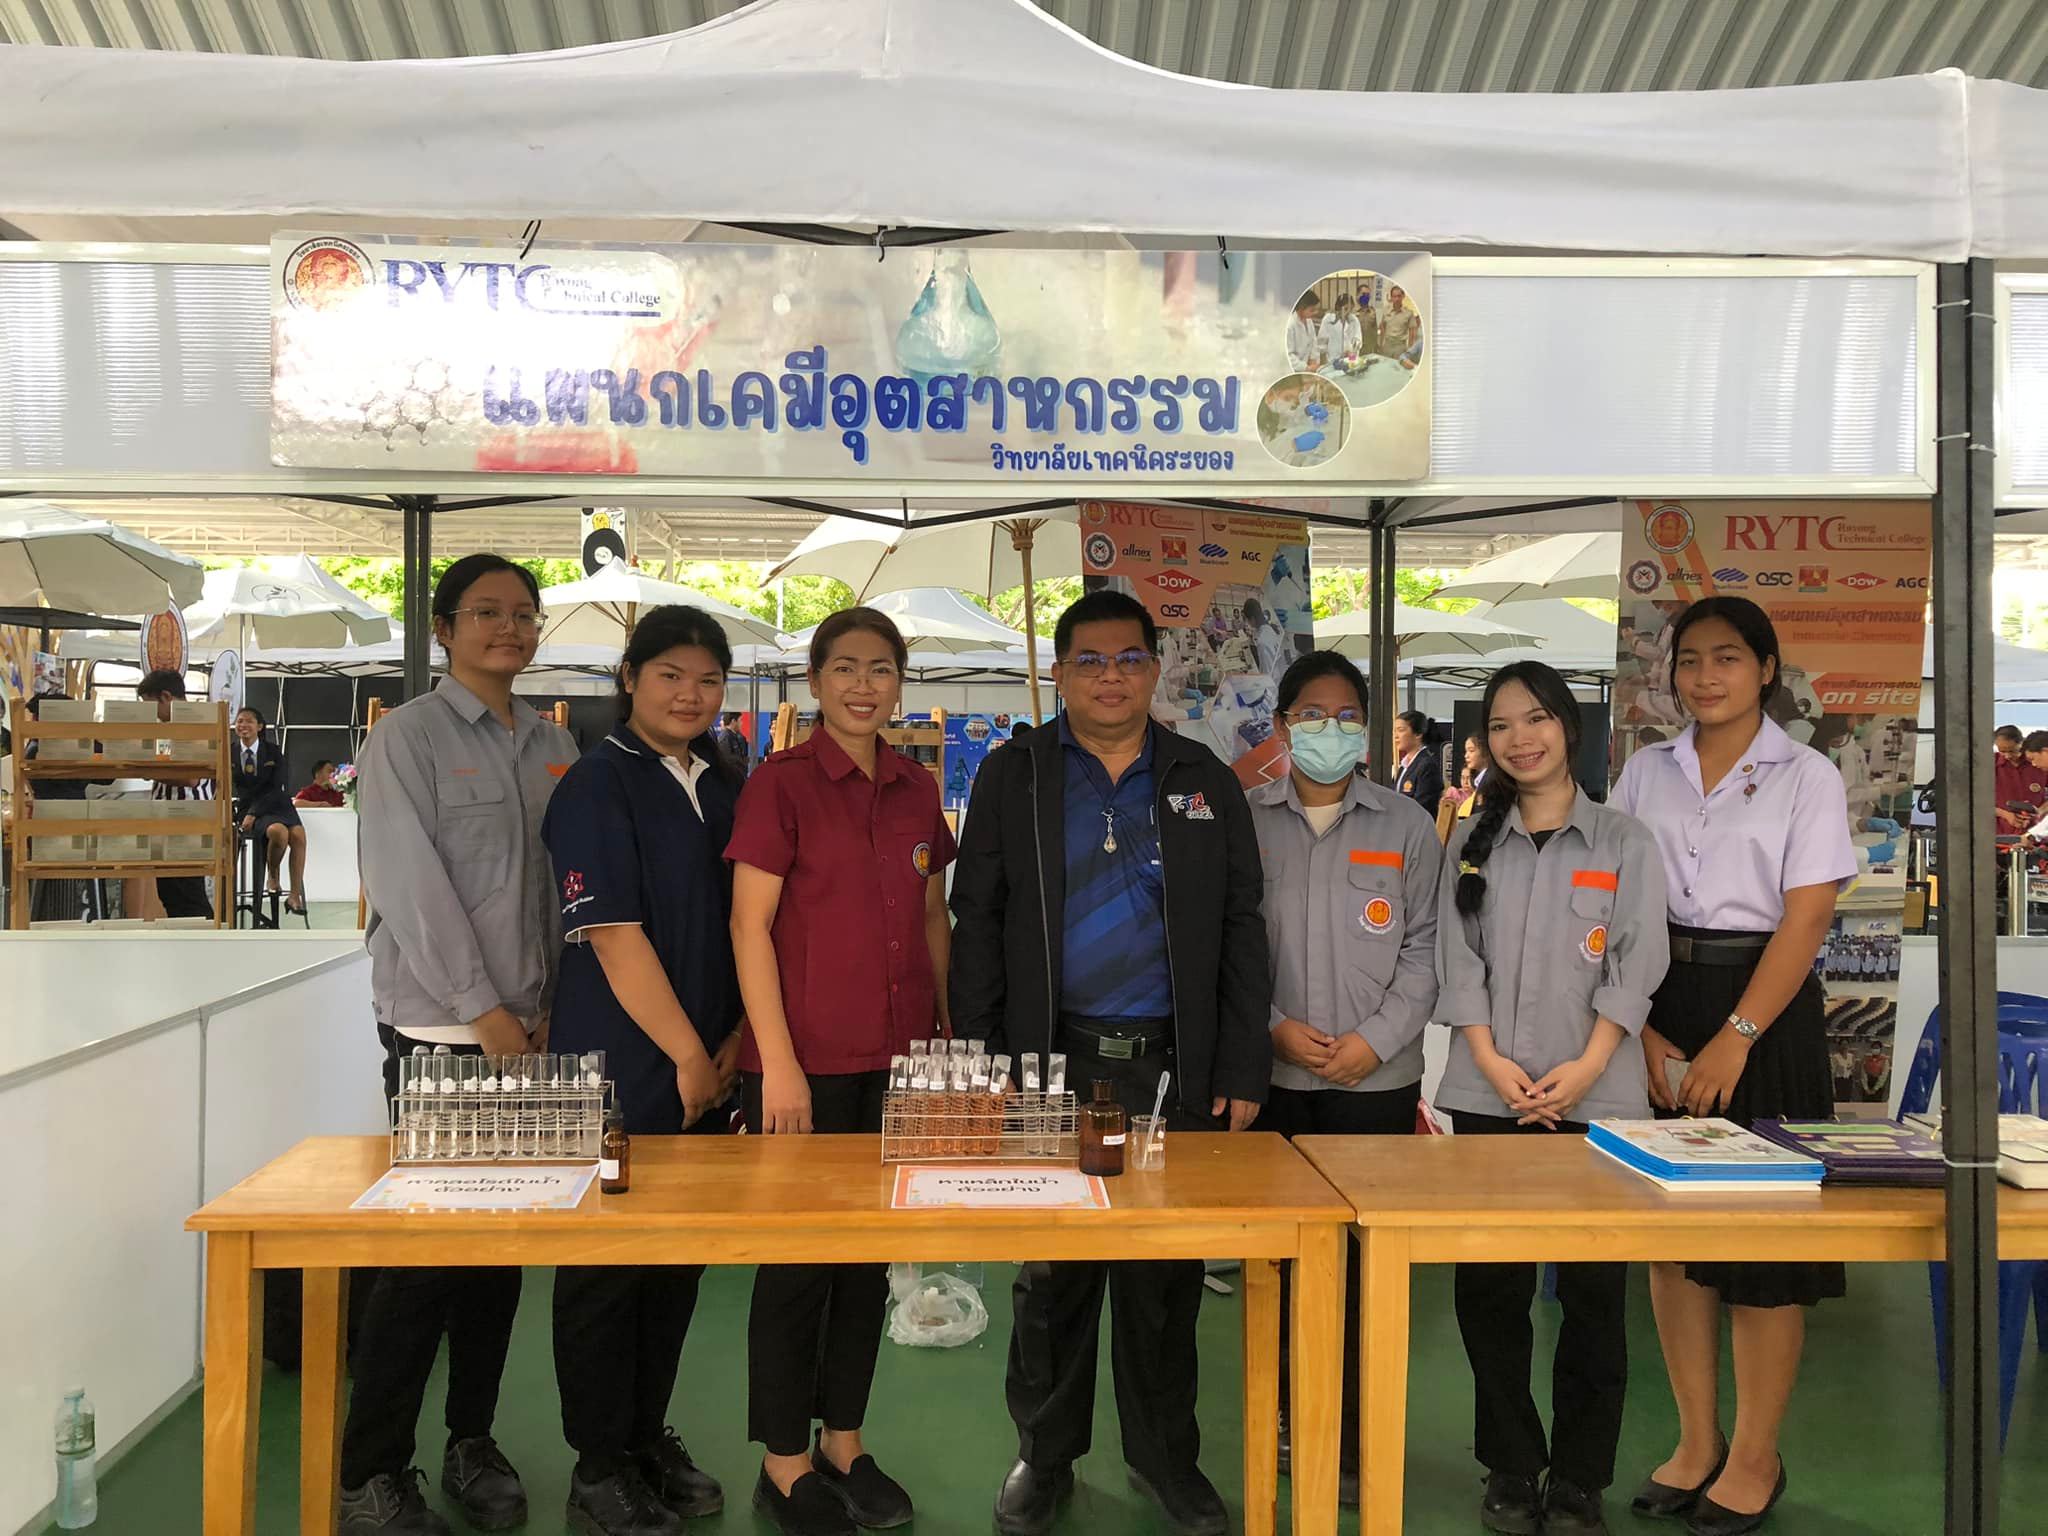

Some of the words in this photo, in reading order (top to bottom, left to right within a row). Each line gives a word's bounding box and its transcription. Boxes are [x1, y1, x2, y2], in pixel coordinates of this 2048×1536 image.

[381, 258, 552, 312] RYTC
[540, 273, 592, 290] Ryong
[542, 287, 606, 304] Thnical
[610, 290, 661, 307] College
[483, 346, 1240, 465] แผนกเคมีอุตสาหกรรม
[992, 443, 1234, 472] วิทยาลัยเทคนิคระยอง
[1108, 505, 1162, 529] RYTC
[1721, 515, 1848, 552] RYTC
[1121, 543, 1152, 559] allnex
[1240, 549, 1263, 563] AGC
[1666, 567, 1703, 582] allnex
[1895, 576, 1929, 589] AGC
[1822, 690, 1856, 705] on
[1863, 688, 1917, 706] site
